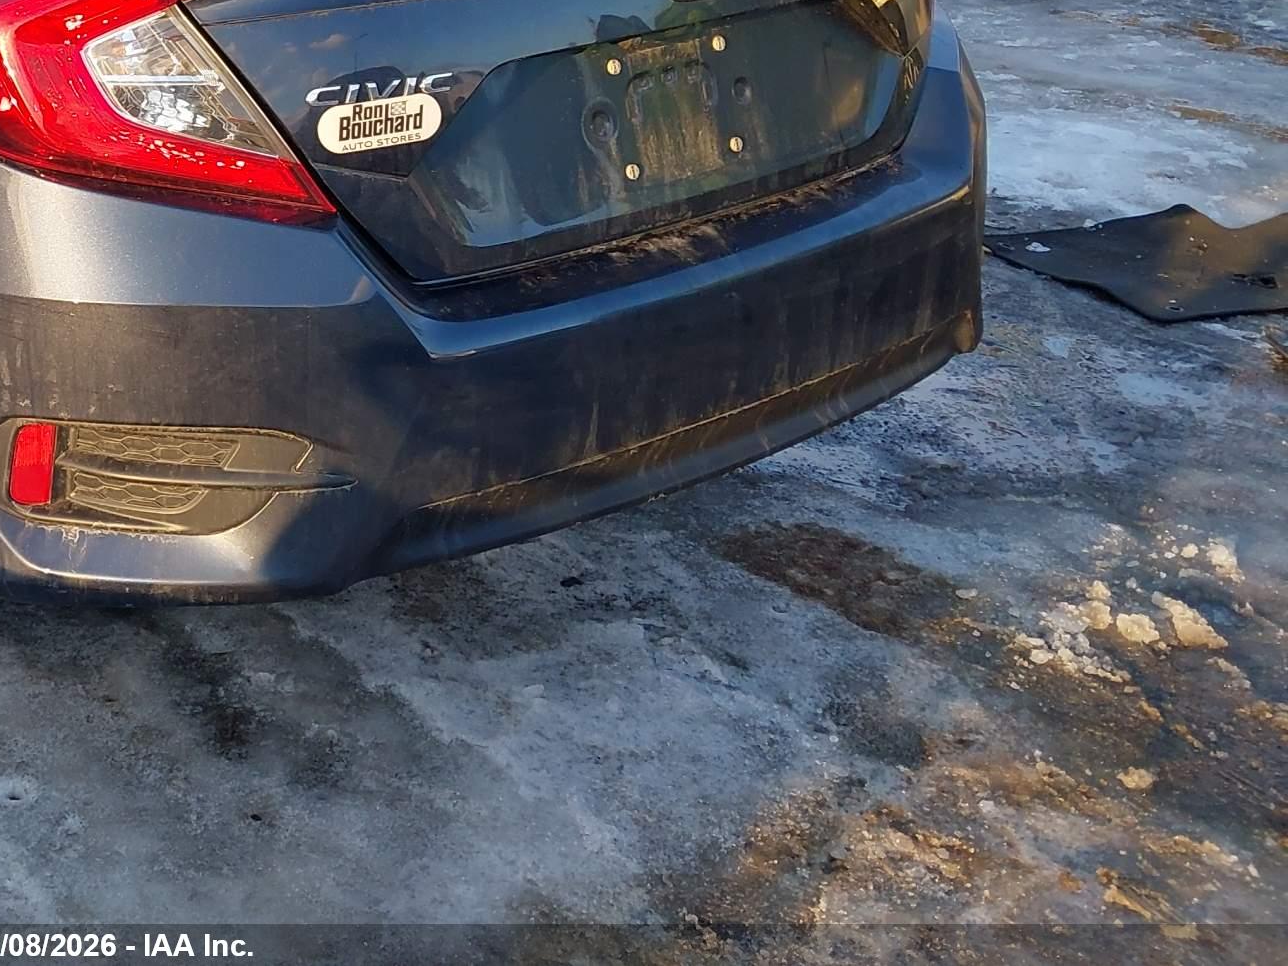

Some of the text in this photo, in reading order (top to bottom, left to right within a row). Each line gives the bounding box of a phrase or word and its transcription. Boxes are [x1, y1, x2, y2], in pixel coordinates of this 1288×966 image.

[304, 72, 454, 107] CIVIC
[338, 103, 424, 142] Bouchard
[352, 104, 383, 122] Ron
[341, 133, 422, 151] AUTO STORES
